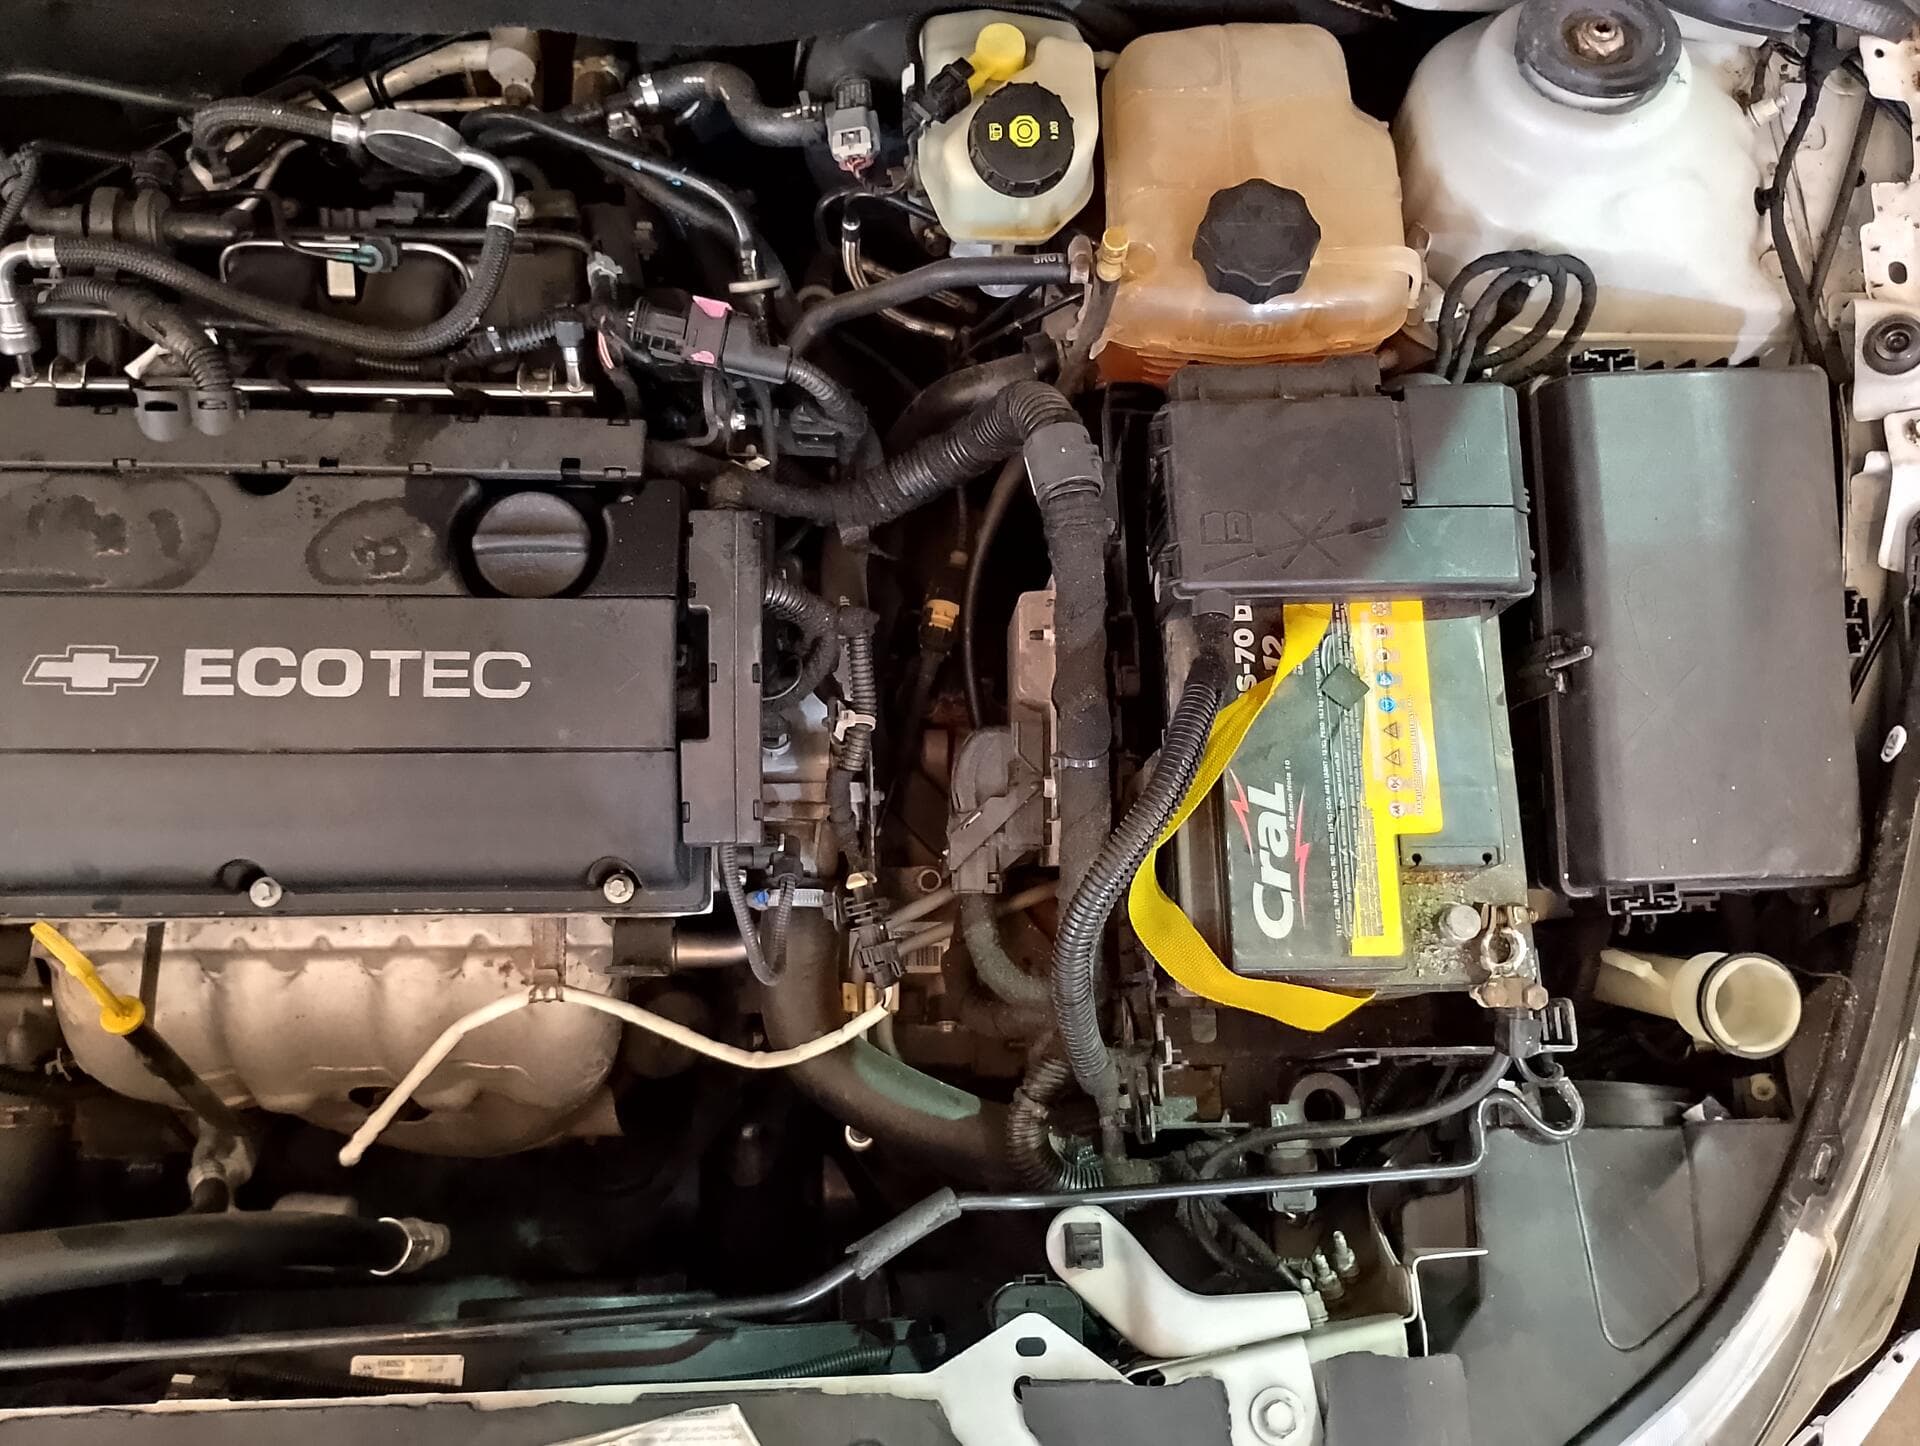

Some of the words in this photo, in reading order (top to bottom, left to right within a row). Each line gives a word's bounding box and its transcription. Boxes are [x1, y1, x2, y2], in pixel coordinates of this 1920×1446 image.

[183, 647, 532, 699] ECOTEC
[1233, 629, 1257, 698] S-70
[1262, 635, 1284, 670] 12
[1284, 760, 1291, 770] 10
